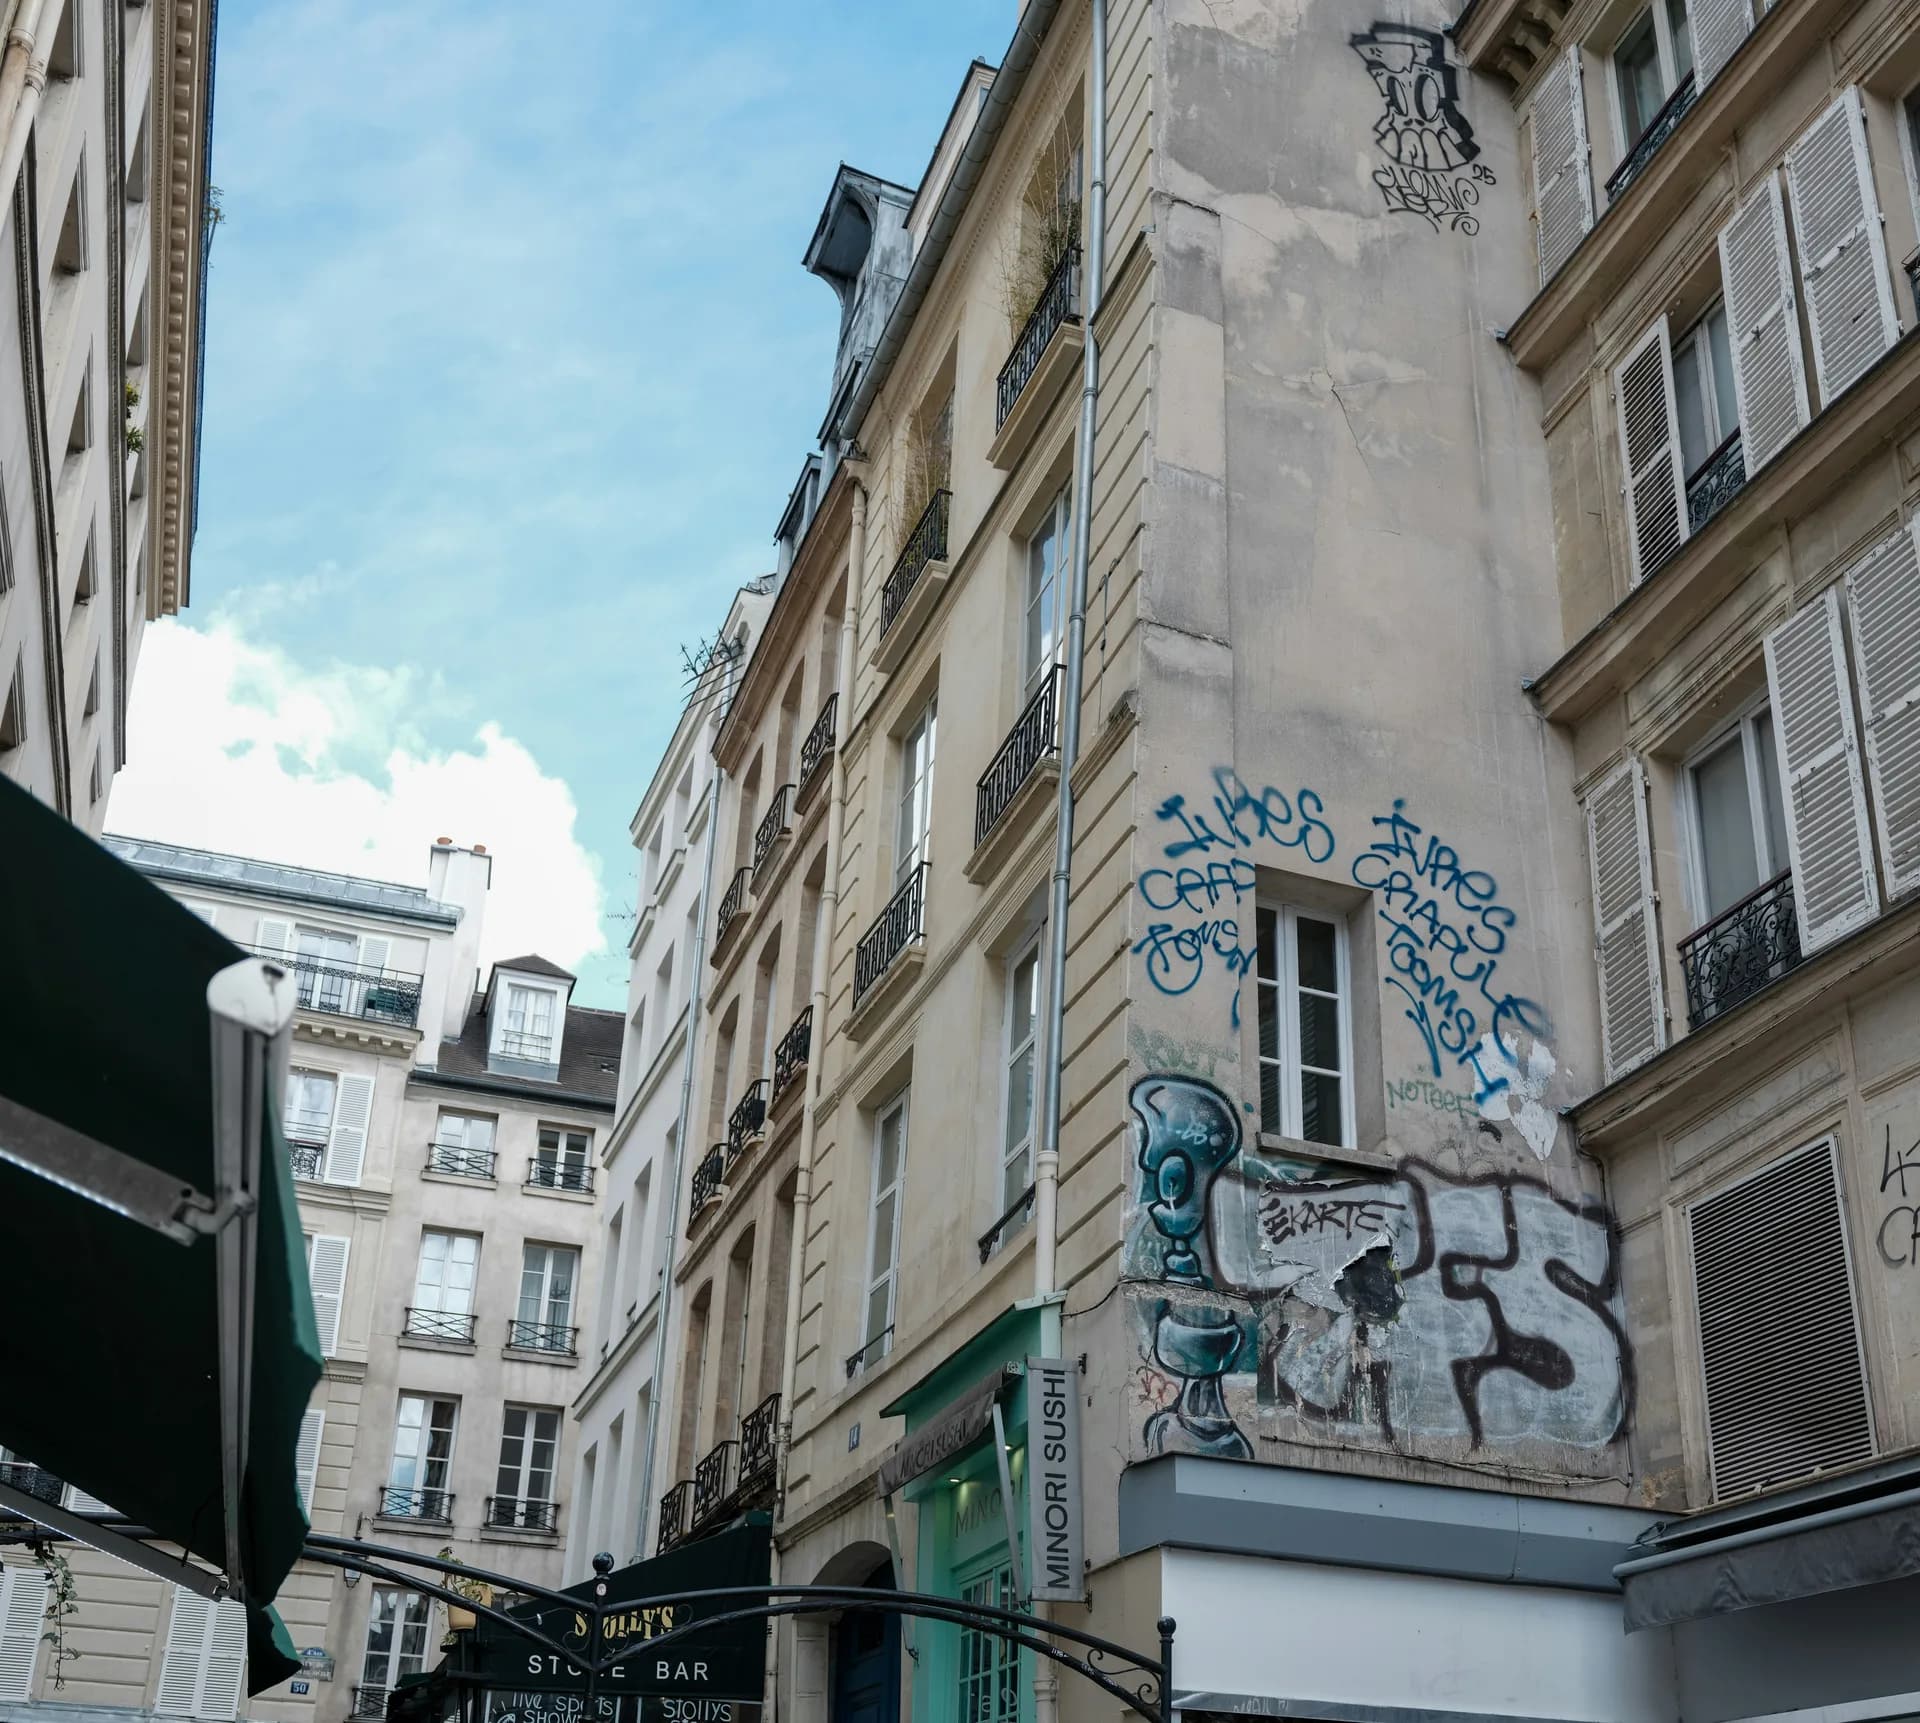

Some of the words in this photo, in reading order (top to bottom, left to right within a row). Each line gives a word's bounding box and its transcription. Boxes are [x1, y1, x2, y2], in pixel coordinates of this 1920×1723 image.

[1472, 164, 1497, 186] 25
[1043, 1369, 1067, 1463] SUSHI
[1044, 1472, 1071, 1589] MINORI
[574, 1606, 674, 1640] SOLLY'S
[656, 1660, 709, 1681] BAR
[292, 1682, 307, 1693] 50
